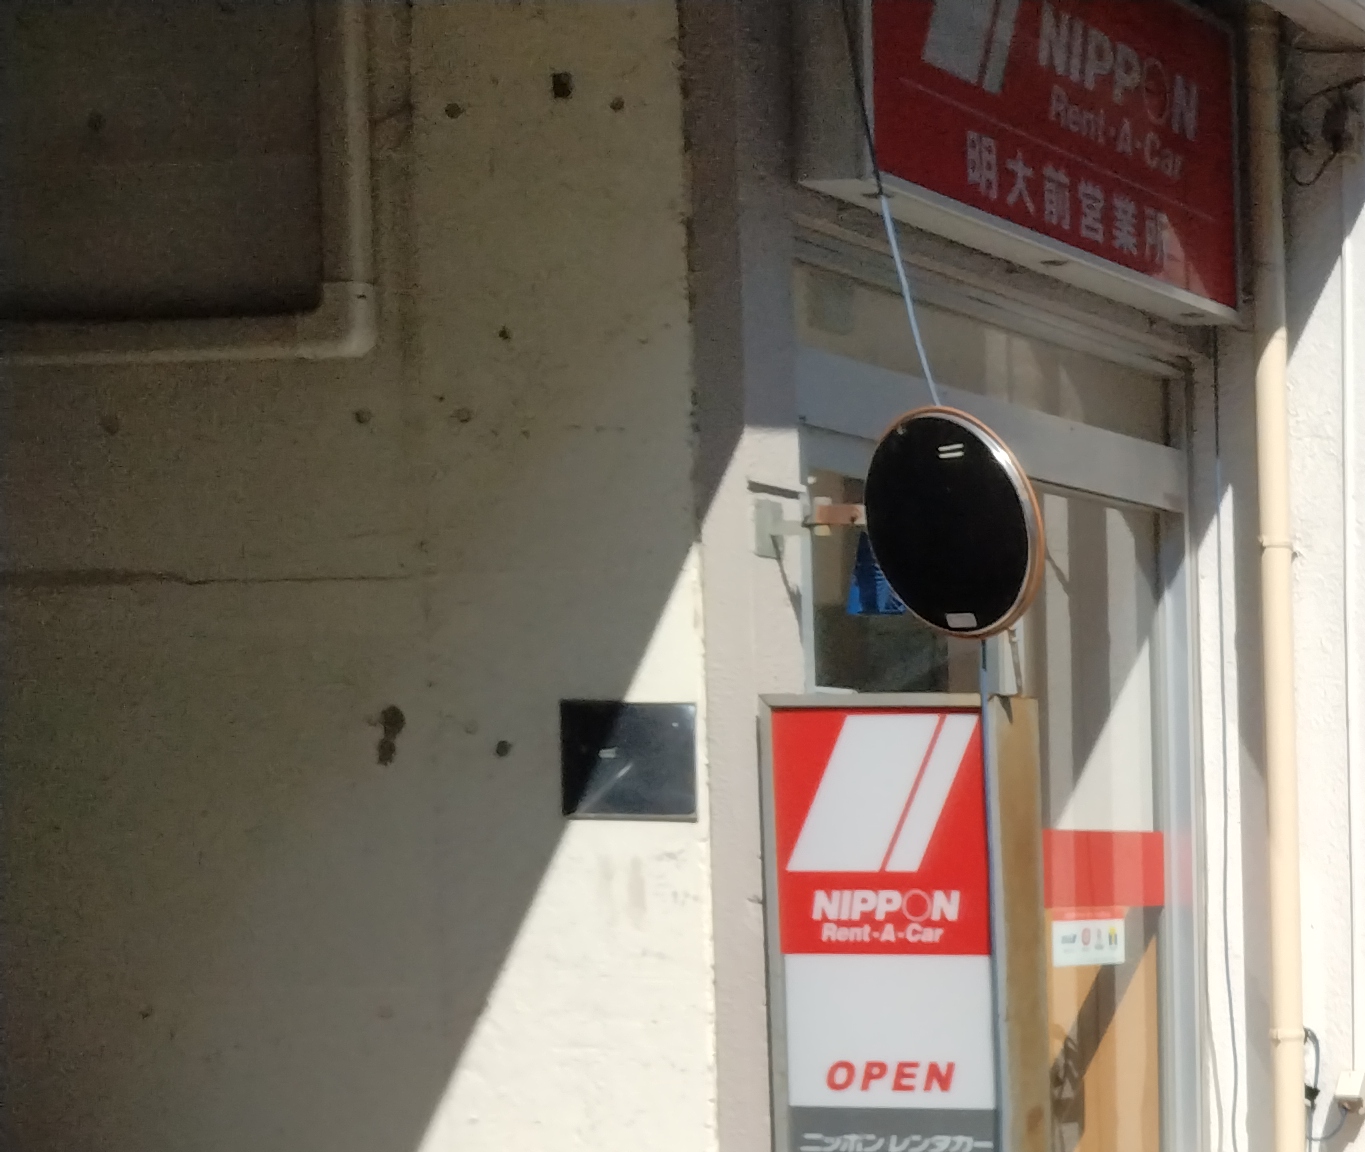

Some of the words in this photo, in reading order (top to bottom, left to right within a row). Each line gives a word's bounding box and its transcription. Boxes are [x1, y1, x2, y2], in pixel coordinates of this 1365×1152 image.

[1038, 2, 1199, 141] NIPPON
[812, 889, 961, 921] NIPPON
[826, 1060, 956, 1092] OPEN
